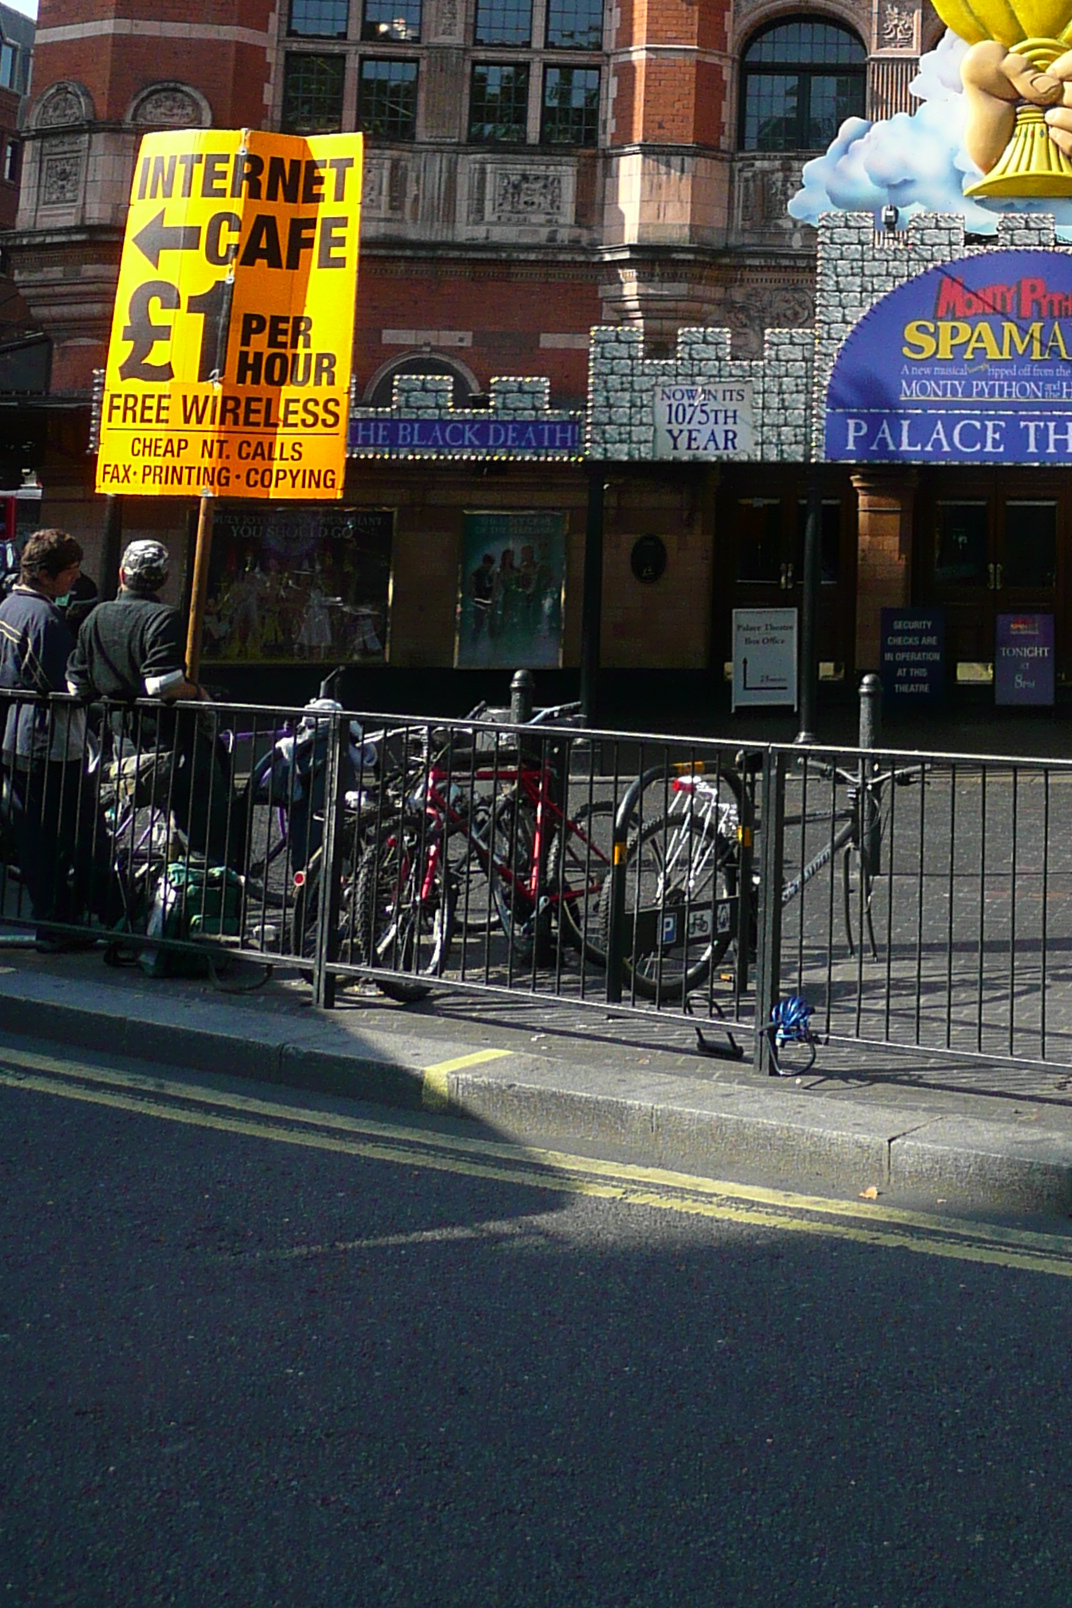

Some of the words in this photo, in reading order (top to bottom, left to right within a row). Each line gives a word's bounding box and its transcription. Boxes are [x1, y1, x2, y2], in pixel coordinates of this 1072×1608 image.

[137, 153, 354, 204] INTERNET
[205, 211, 349, 270] CAFE
[118, 279, 233, 383] £1
[240, 312, 313, 349] PER
[236, 350, 337, 387] HOUR
[900, 364, 910, 375] A
[911, 367, 931, 375] new
[934, 364, 968, 375] musical
[988, 364, 1017, 379] ripped
[1018, 364, 1033, 376] off
[1033, 364, 1054, 376] from
[1056, 365, 1071, 376] the
[660, 388, 699, 401] NOW
[703, 388, 717, 402] IN
[722, 389, 745, 402] ITS
[900, 380, 965, 398] MONTY
[972, 380, 1043, 399] PYTHON
[107, 393, 171, 424] FREE
[182, 394, 340, 429] WIRELESS
[666, 403, 738, 425] 1075TH
[400, 422, 480, 447] BLACK
[484, 423, 579, 448] DEATH!
[665, 429, 738, 451] YEAR
[845, 418, 1004, 452] PALACE
[131, 437, 188, 458] CHEAP
[237, 441, 303, 462] CALLS
[141, 465, 230, 488] PRINTING
[245, 468, 336, 490] COPYING
[892, 620, 932, 630] SECURITY
[887, 636, 919, 646] CHECKS
[921, 636, 938, 646] ARE
[1000, 646, 1050, 658] TONIGHT
[884, 652, 893, 661] IN
[895, 652, 940, 662] OPERATION
[896, 667, 907, 677] AT
[909, 667, 928, 677] THIS
[894, 683, 930, 693] THEATRE
